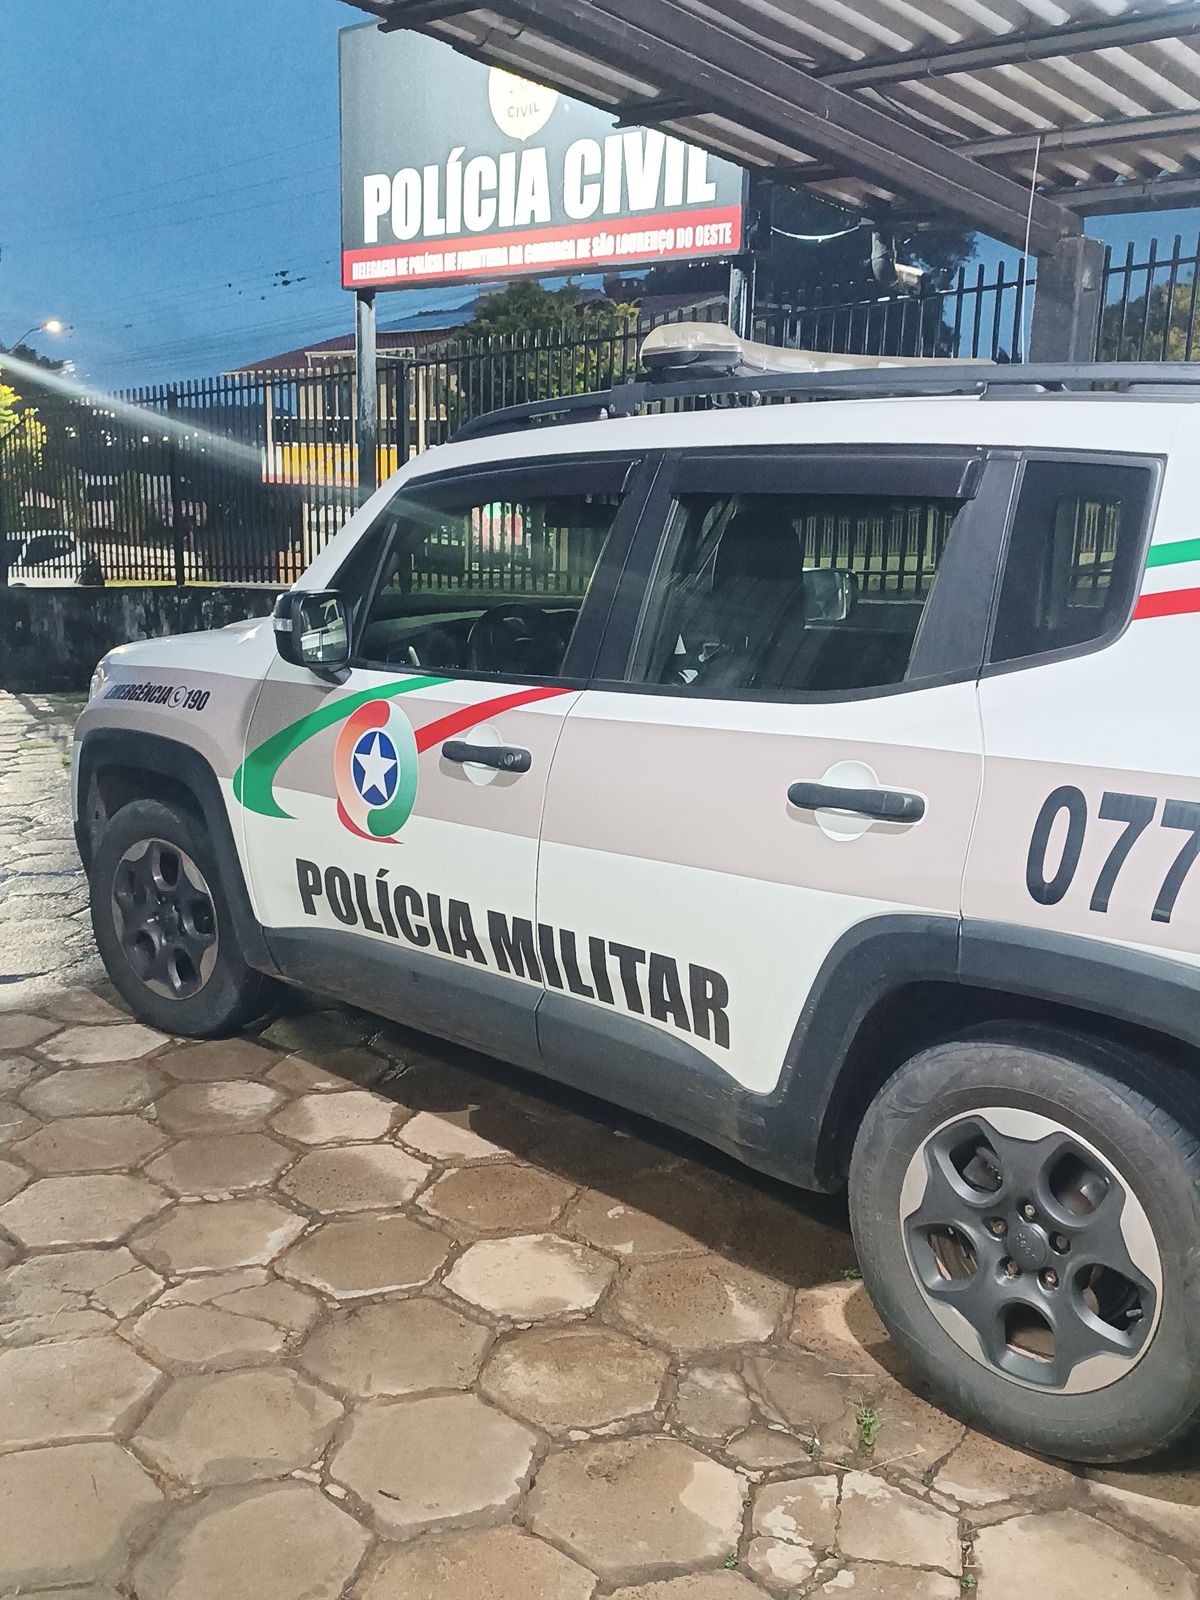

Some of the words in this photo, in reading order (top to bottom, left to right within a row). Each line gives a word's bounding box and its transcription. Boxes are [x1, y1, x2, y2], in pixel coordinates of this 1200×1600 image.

[507, 103, 541, 118] CIVIL
[363, 146, 552, 244] POLÍCIA
[563, 128, 716, 220] CIVIL
[409, 252, 444, 275] POLÍCIA
[576, 237, 591, 259] DE
[592, 232, 615, 257] SÃO
[615, 228, 675, 255] LOURENÇO
[676, 226, 694, 249] DO
[695, 222, 733, 247] OESTE
[103, 682, 173, 704] EMERGÊNCIA
[182, 689, 211, 711] 190
[1026, 785, 1200, 923] 077
[296, 858, 488, 966] POLÍCIA
[487, 909, 730, 1050] MILITAR
